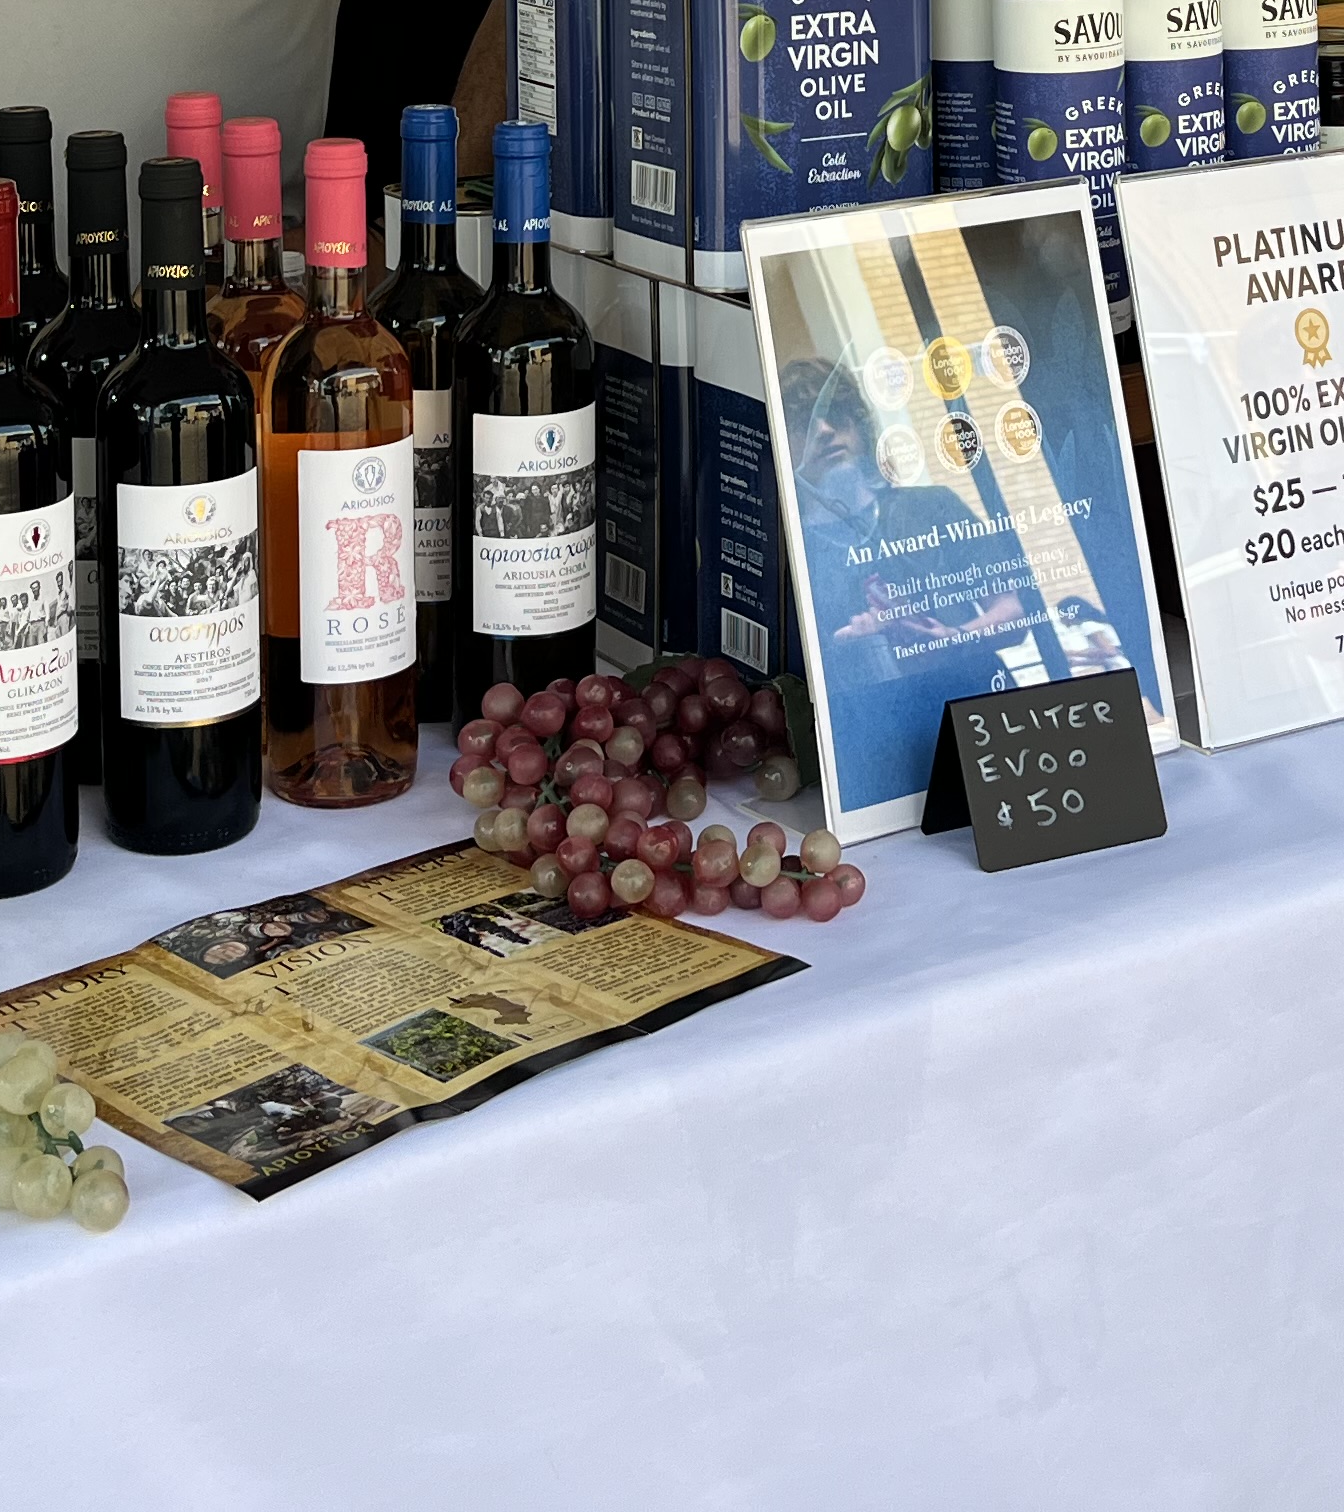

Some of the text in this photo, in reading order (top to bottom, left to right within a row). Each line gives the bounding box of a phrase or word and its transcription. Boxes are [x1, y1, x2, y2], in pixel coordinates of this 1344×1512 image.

[790, 10, 876, 40] EXTRA
[788, 39, 879, 71] VIRGIN
[801, 73, 866, 98] OLIVE
[815, 100, 852, 121] OIL
[822, 152, 846, 167] Cold
[808, 168, 861, 184] Extraction
[1240, 385, 1311, 422] 100%
[1222, 422, 1314, 464] VIRGIN
[517, 454, 579, 473] ARIOUSIOS
[341, 493, 395, 511] ARIOUSIOS
[1253, 477, 1305, 516] $25
[846, 497, 1092, 566] An Award-Winning Legacy
[1245, 528, 1296, 566] $20
[0, 551, 64, 577] ARIOUSIOS
[503, 563, 587, 580] ARIOUSIA CHORA
[887, 547, 1068, 599] Built through consistency,
[1269, 581, 1324, 602] Unique
[326, 604, 406, 636] ROSÉ
[1285, 606, 1306, 623] No
[175, 646, 231, 664] AFSTIROS
[8, 676, 63, 699] GLIKAZON
[969, 700, 1114, 747] 3 LITER
[979, 748, 1088, 782] EVOO
[996, 788, 1085, 828] $50
[250, 934, 374, 981] VISION
